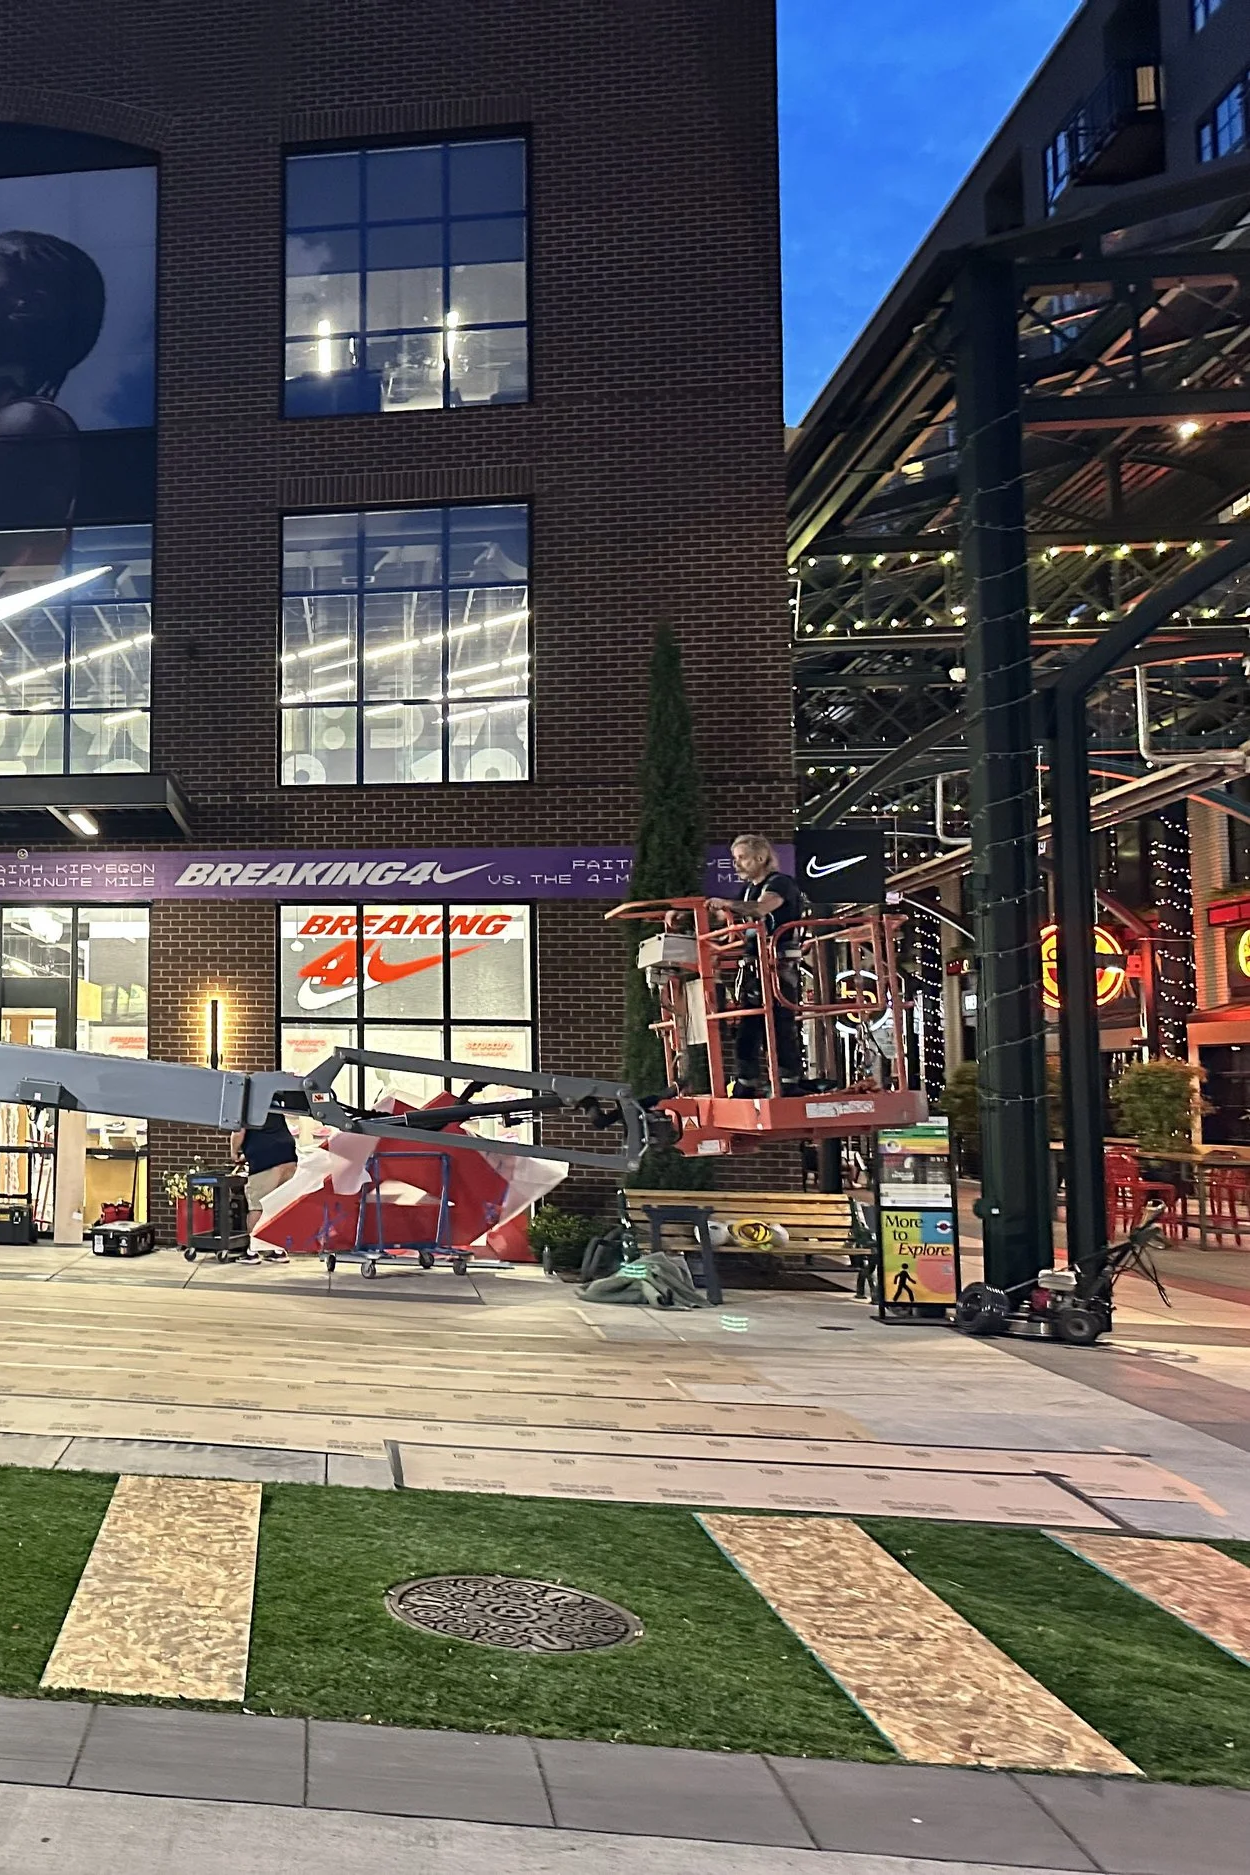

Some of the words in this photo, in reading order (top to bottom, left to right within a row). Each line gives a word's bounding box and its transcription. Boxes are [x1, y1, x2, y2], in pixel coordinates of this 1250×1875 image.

[56, 863, 155, 874] KIPYEGON
[572, 859, 633, 870] FAIT
[174, 862, 438, 886] BREAKING4
[487, 874, 521, 885] VS.
[530, 874, 572, 884] THE
[105, 877, 155, 887] MILE
[297, 914, 513, 936] BREAKING
[885, 1214, 924, 1229] More
[893, 1228, 908, 1241] to
